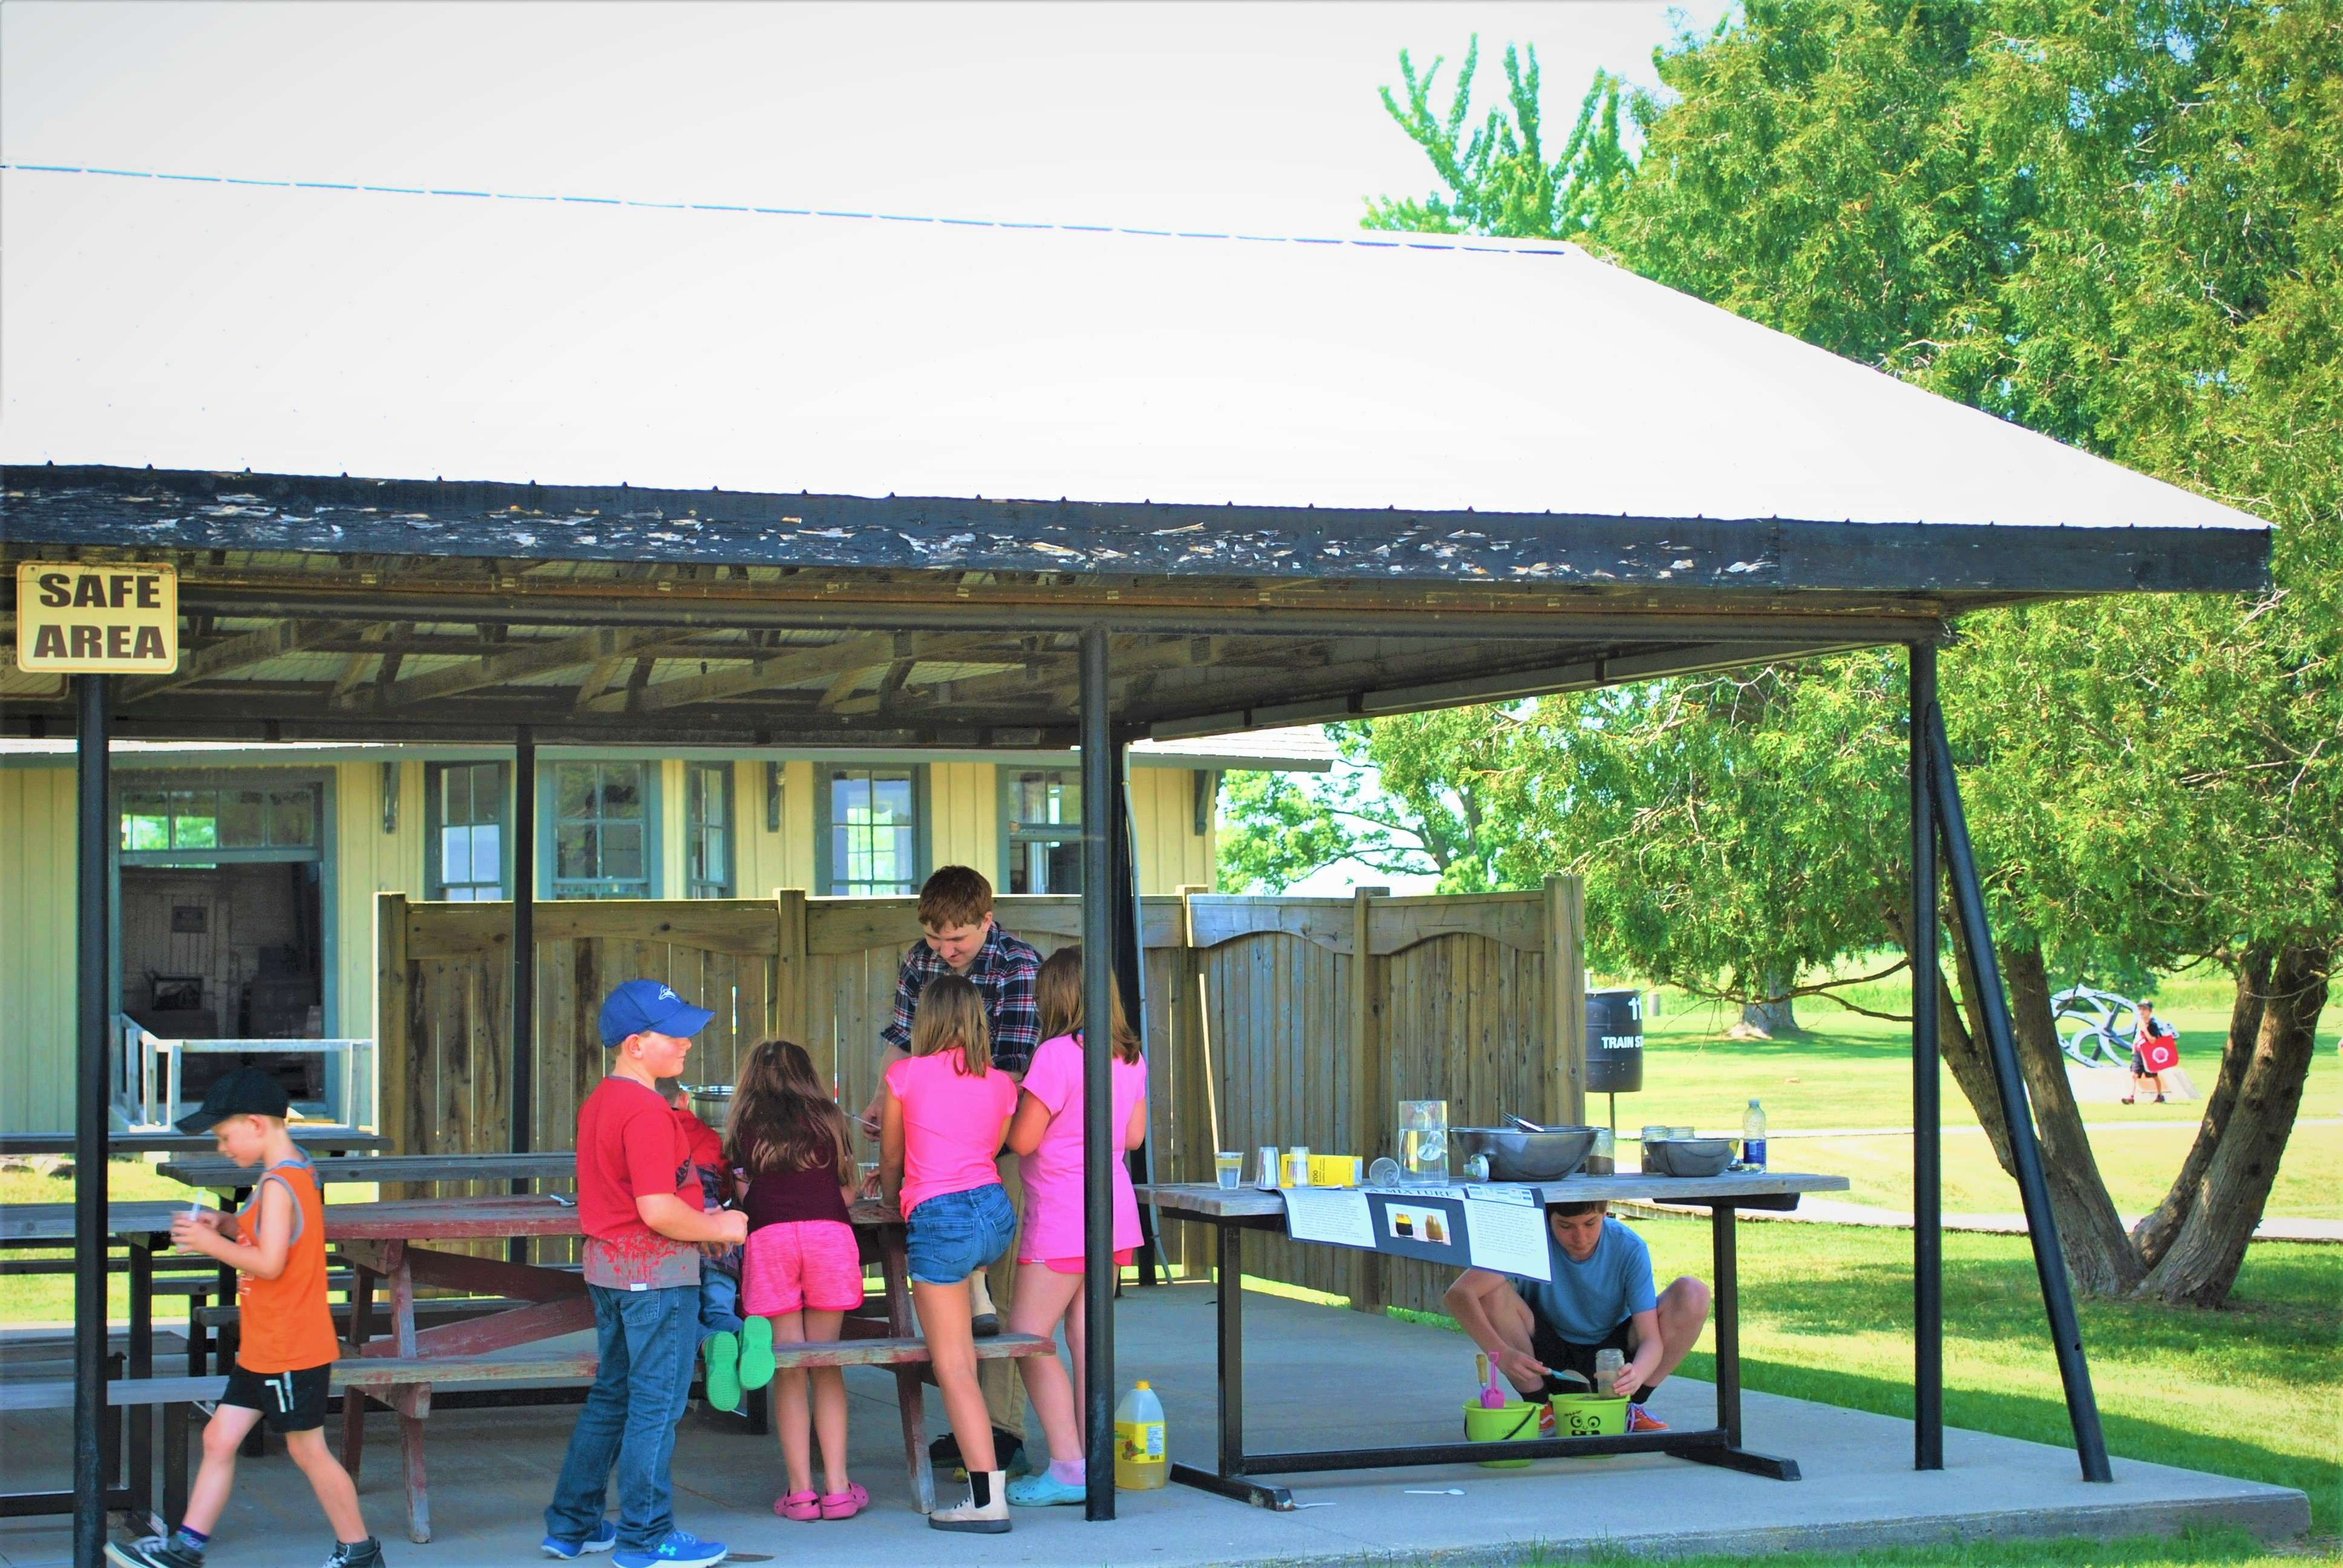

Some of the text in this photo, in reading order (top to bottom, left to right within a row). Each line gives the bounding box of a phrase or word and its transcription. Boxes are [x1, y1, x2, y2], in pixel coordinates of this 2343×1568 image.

[39, 573, 161, 609] SAFE
[33, 624, 167, 659] AREA
[1601, 1036, 1634, 1049] TRAIN
[1384, 1189, 1455, 1197] MIXTURE
